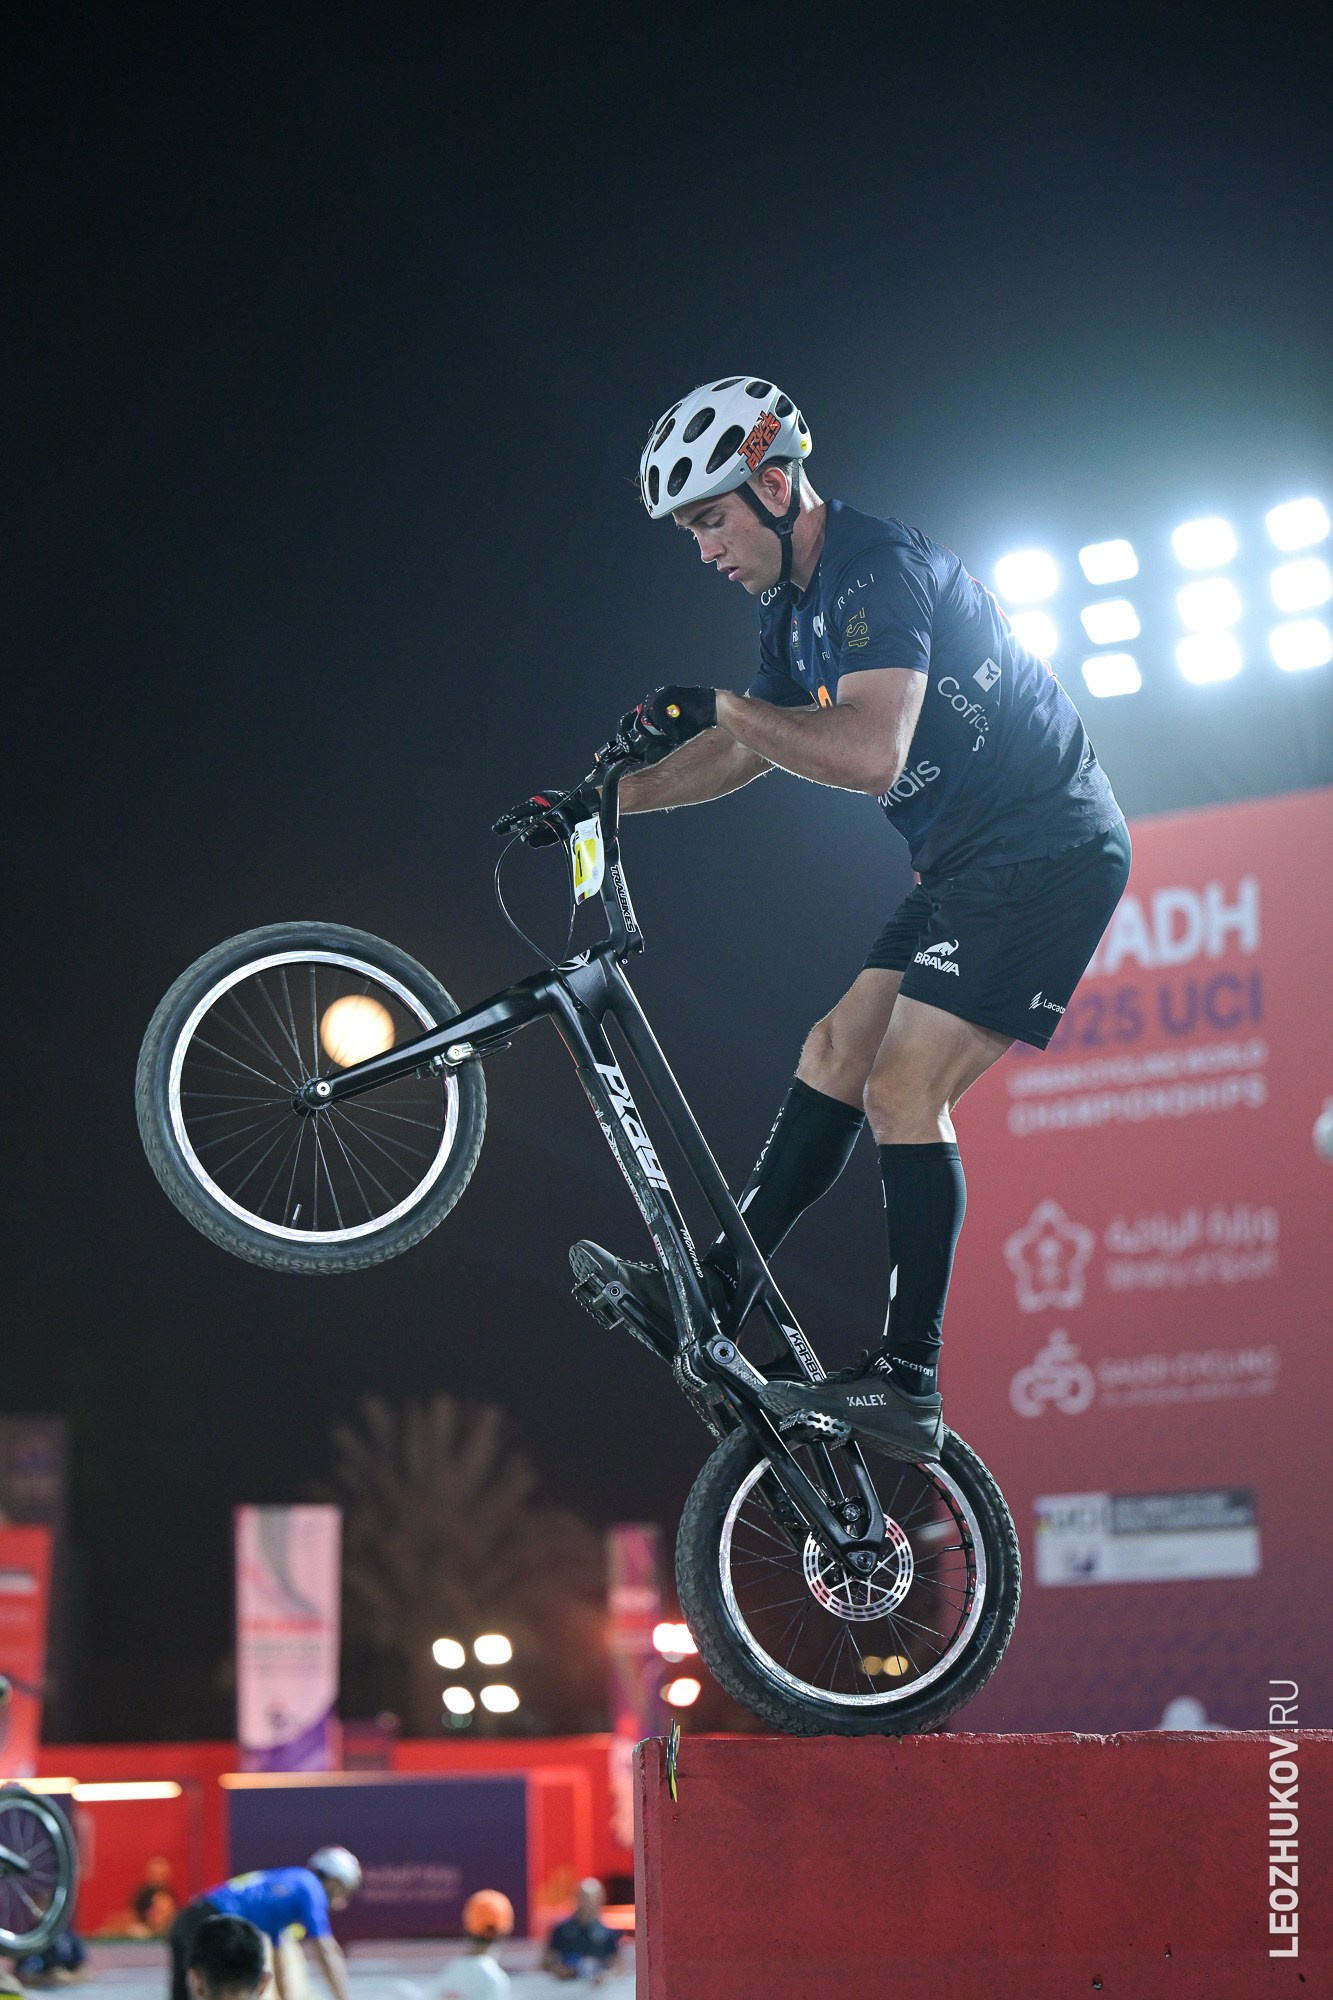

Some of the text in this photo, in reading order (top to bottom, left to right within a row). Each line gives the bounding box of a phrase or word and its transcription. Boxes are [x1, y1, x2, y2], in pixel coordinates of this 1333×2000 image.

[745, 413, 781, 472] BIKES
[937, 676, 989, 752] Cofids
[610, 864, 636, 933] TRIALBIKES
[1083, 876, 1261, 980] ADH
[1013, 970, 1264, 1058] 25 UCI
